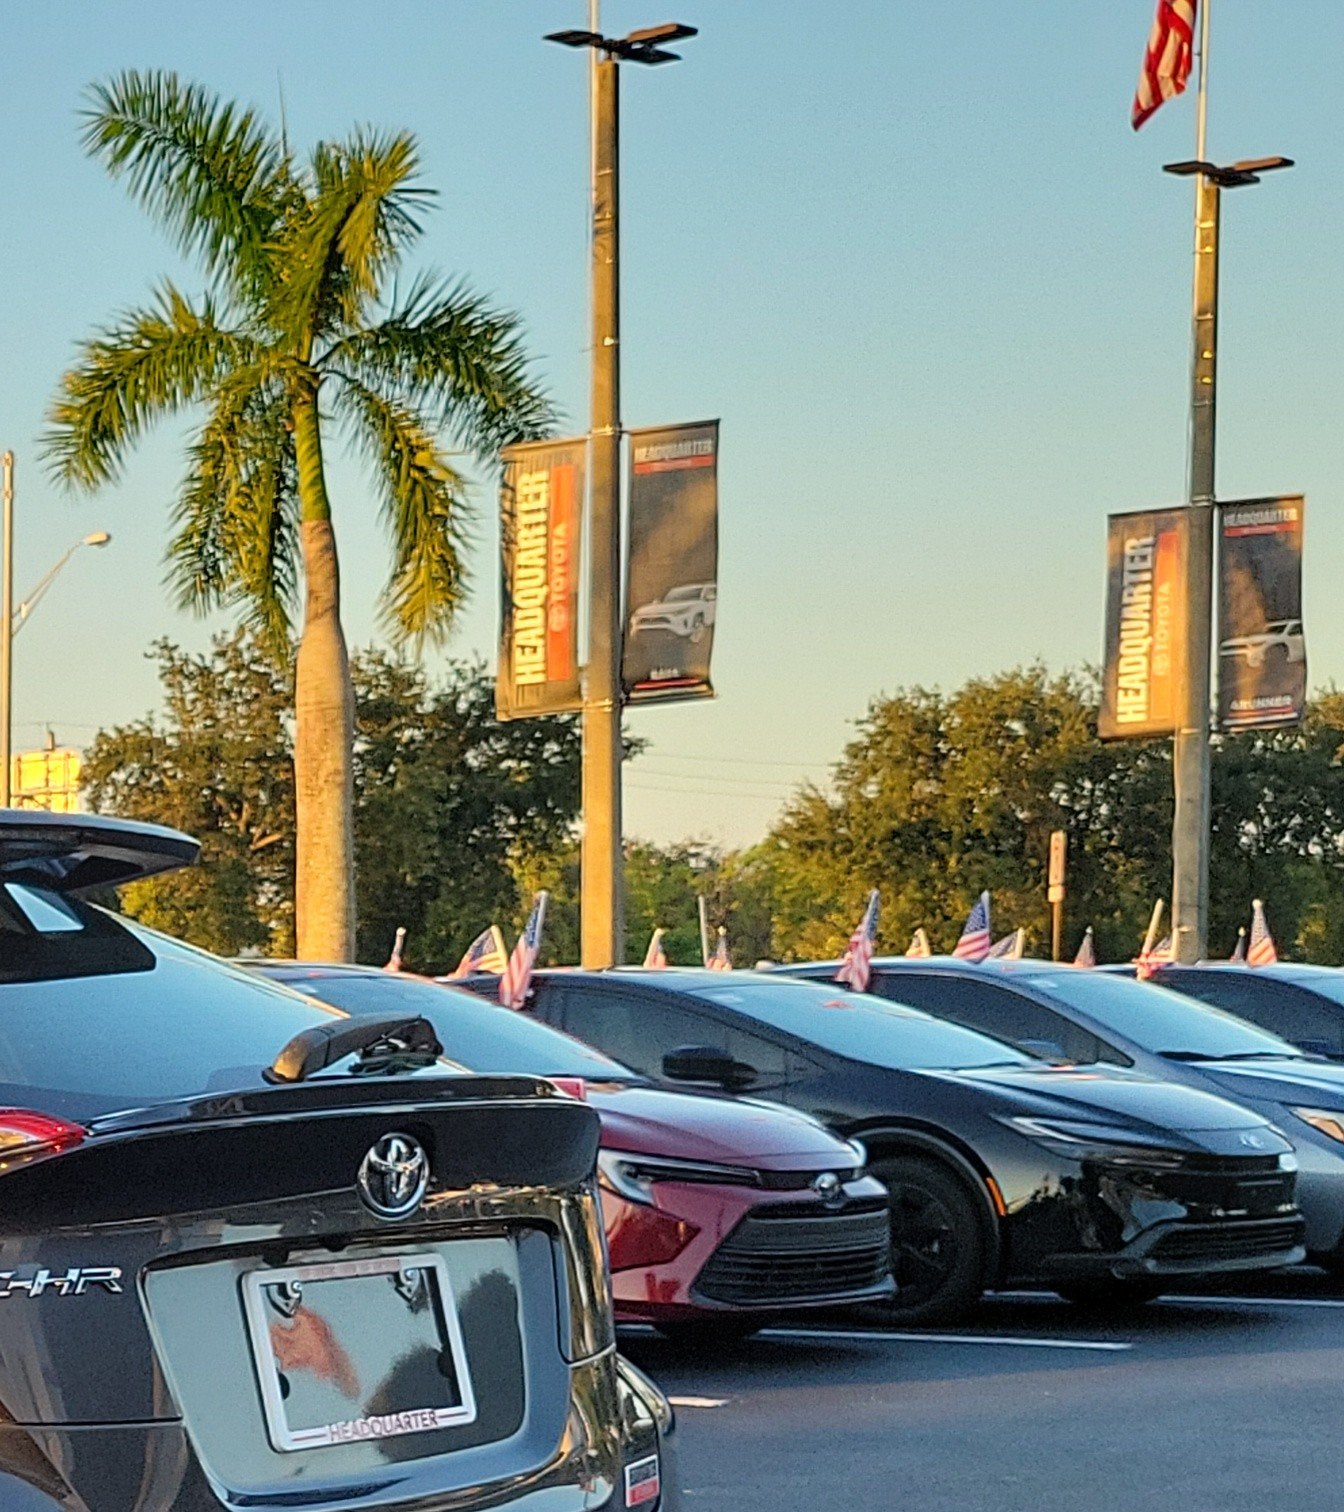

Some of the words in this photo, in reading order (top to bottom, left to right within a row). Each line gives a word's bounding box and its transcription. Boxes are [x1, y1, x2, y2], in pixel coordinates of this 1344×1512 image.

[513, 470, 550, 686] HEADQUARTER
[550, 522, 568, 602] TOYOTA
[1116, 535, 1156, 724] HEADQUARTER
[1154, 582, 1171, 651] TOYOTA
[330, 1409, 438, 1441] HEADQUARTER
